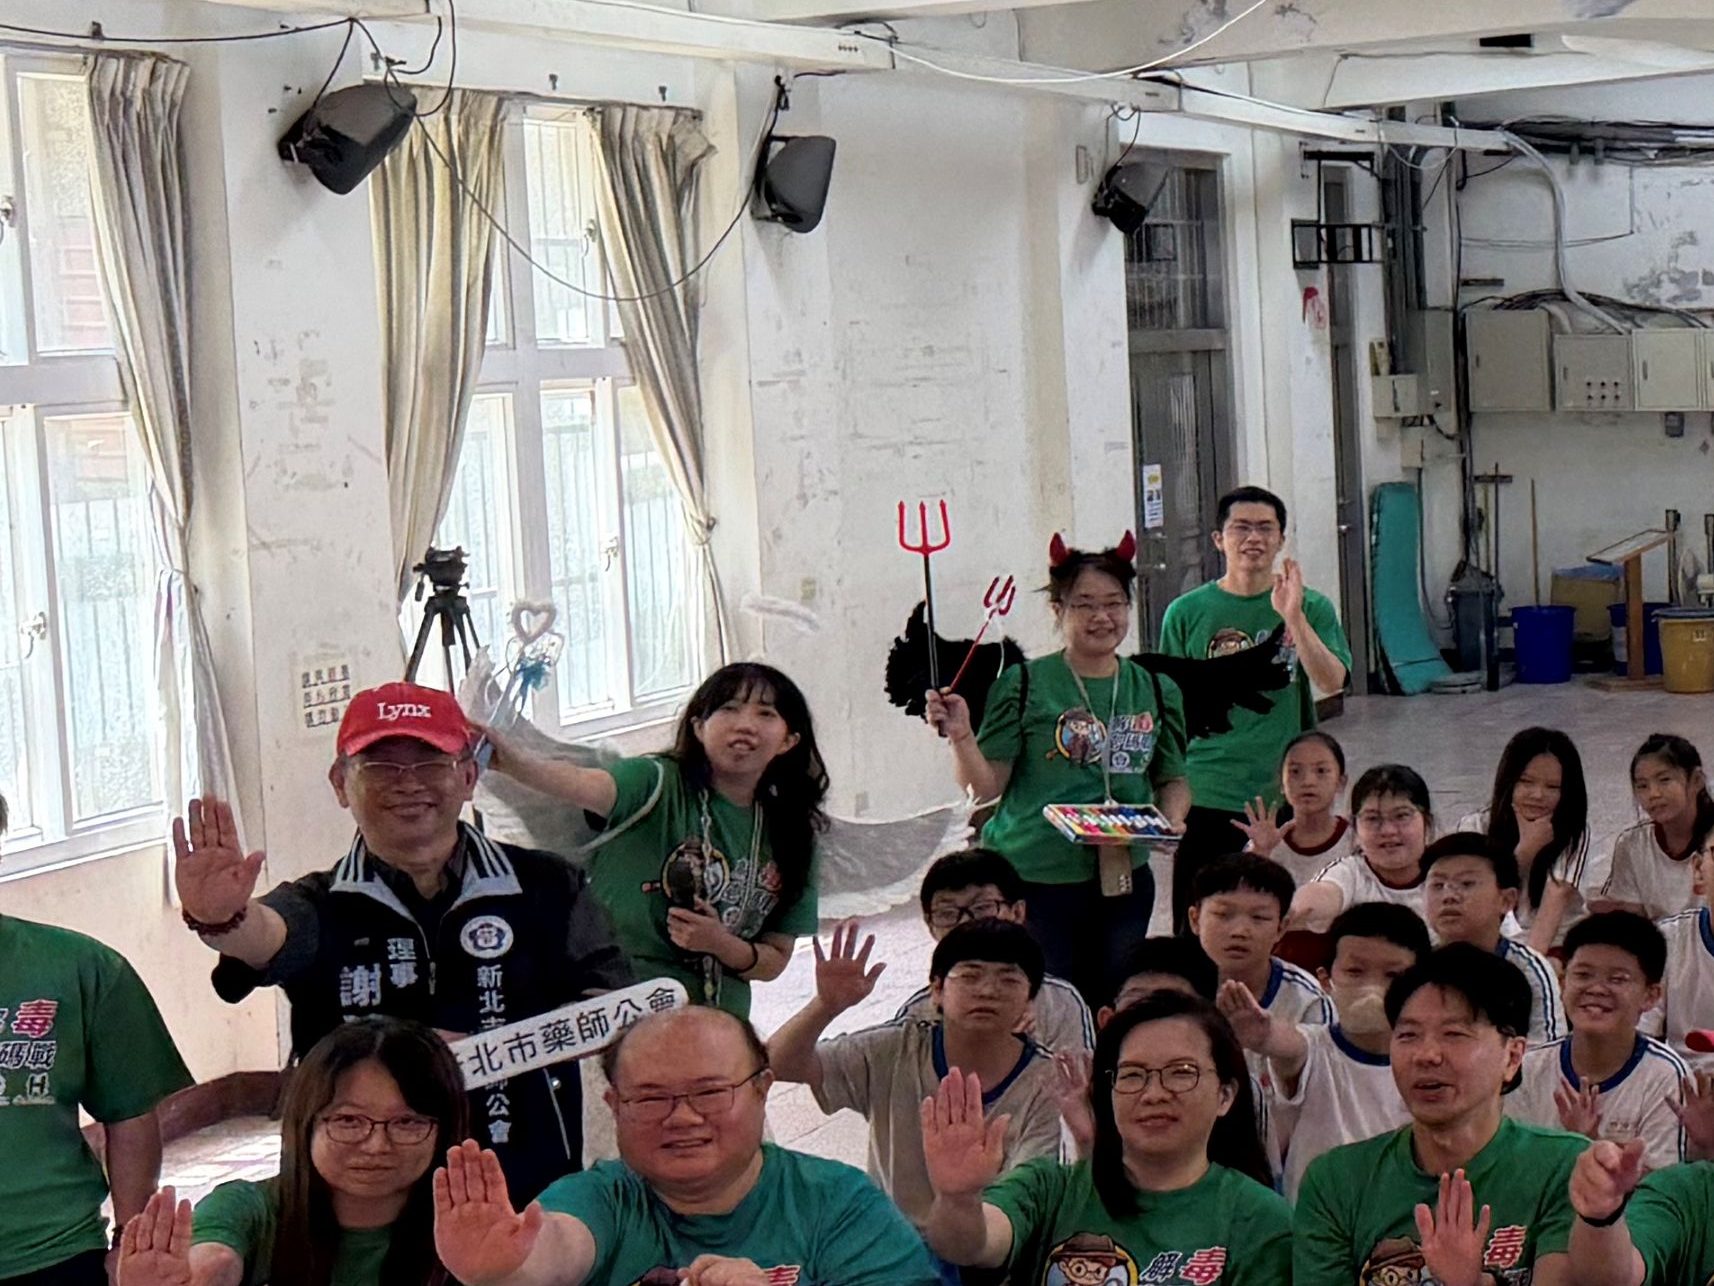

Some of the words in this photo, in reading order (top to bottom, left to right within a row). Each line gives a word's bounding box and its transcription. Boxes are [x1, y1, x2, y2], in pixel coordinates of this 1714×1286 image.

[377, 702, 432, 722] Lynx
[387, 937, 418, 989] 理事
[455, 986, 676, 1077] 北市藥師公會
[1139, 1246, 1227, 1285] 解毒
